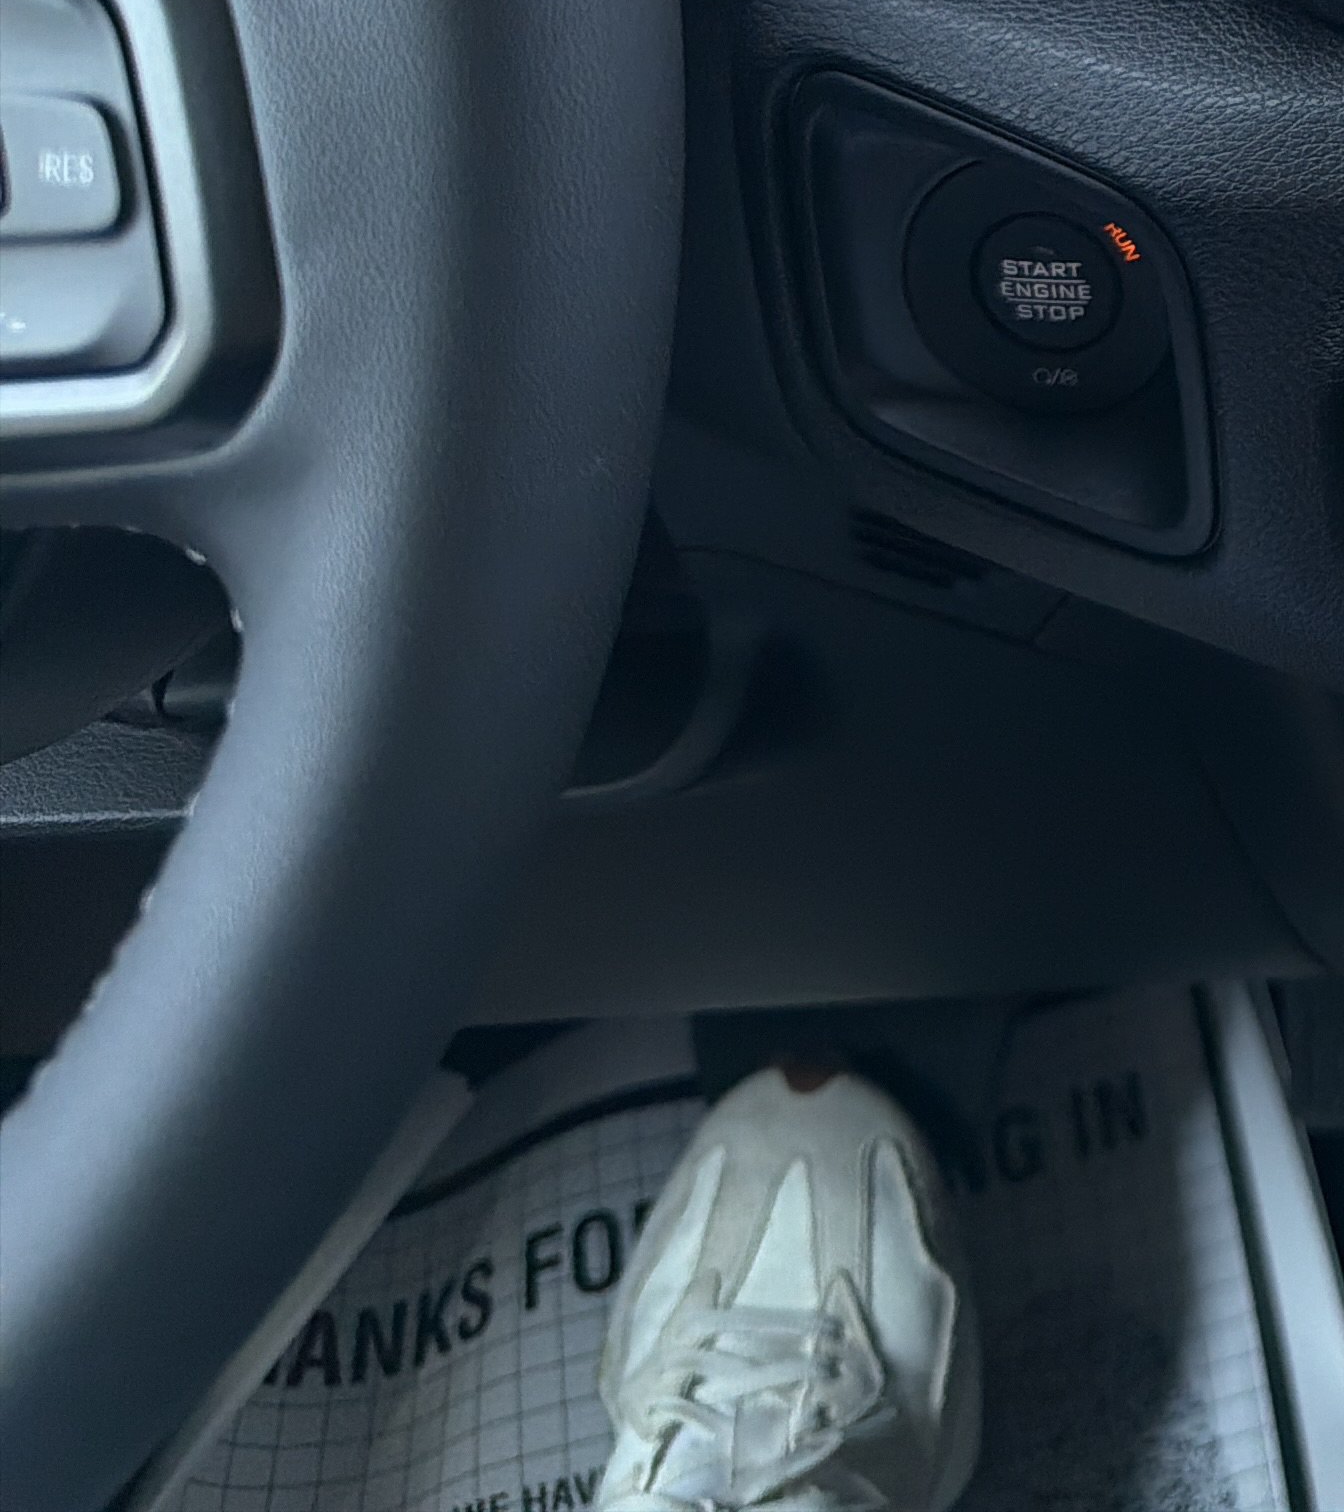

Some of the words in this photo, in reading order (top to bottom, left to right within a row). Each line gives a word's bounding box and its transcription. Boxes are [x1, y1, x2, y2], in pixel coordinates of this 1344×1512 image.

[42, 150, 95, 185] RES
[1104, 222, 1141, 263] RUN
[1002, 259, 1082, 278] START
[1001, 281, 1092, 300] ENGINE
[1016, 304, 1085, 321] STOP
[264, 1257, 493, 1387] ANKS
[1072, 1071, 1145, 1160] IN
